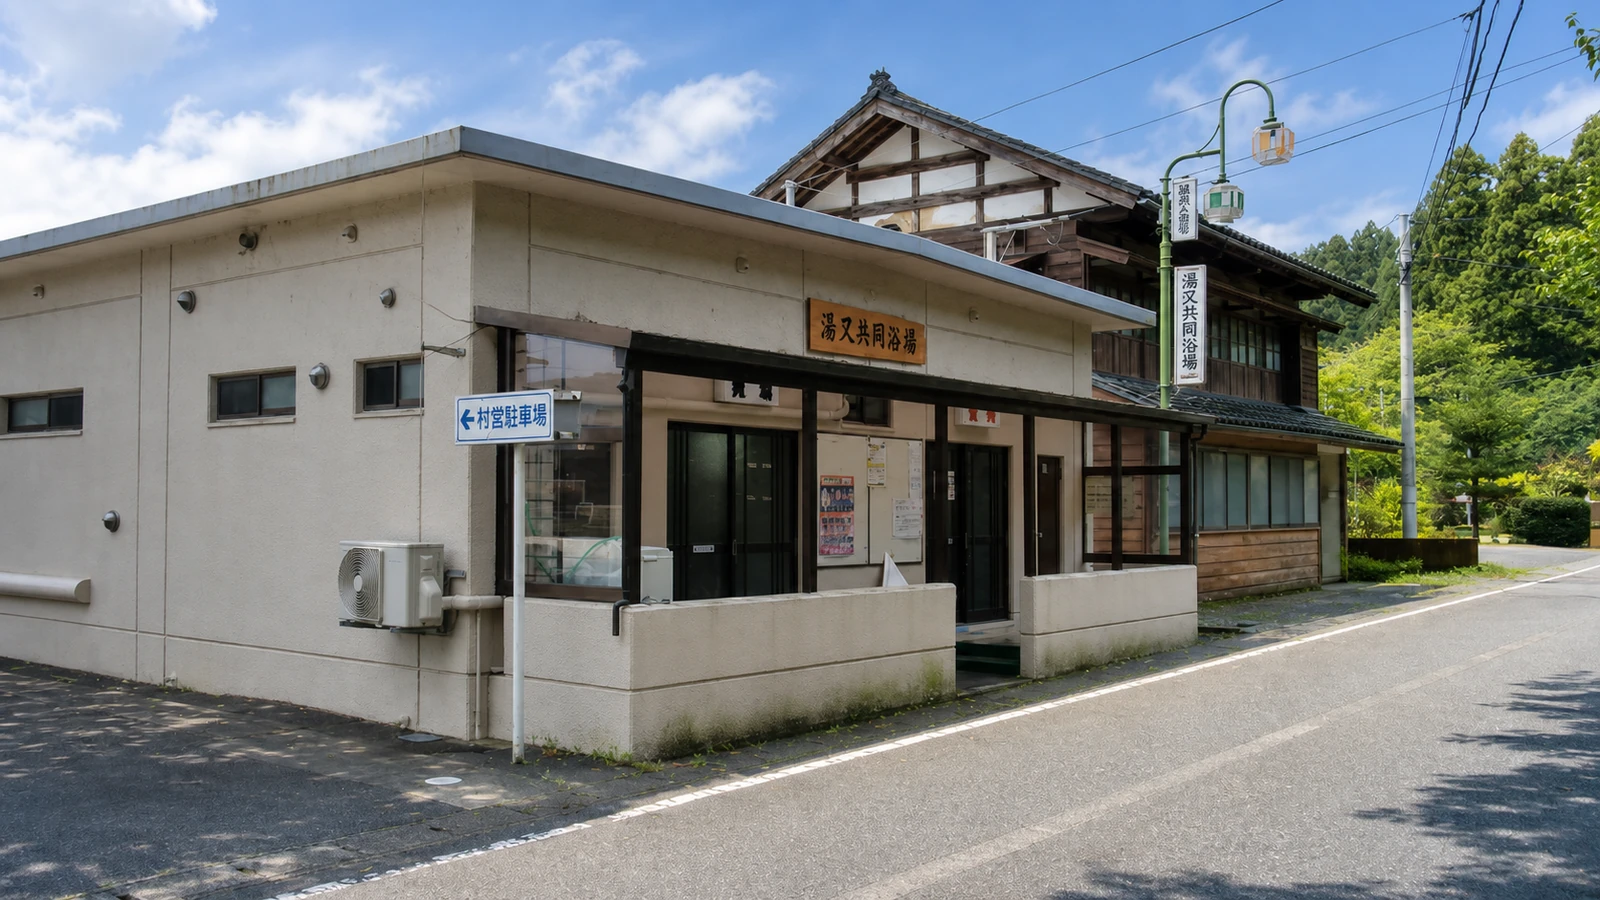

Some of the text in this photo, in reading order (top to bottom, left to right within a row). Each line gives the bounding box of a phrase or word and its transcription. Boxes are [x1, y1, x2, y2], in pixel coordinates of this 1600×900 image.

[821, 312, 917, 355] 湯又共同浴場
[1182, 272, 1198, 371] 湯又共同浴場
[477, 403, 547, 430] 村営駐車場
